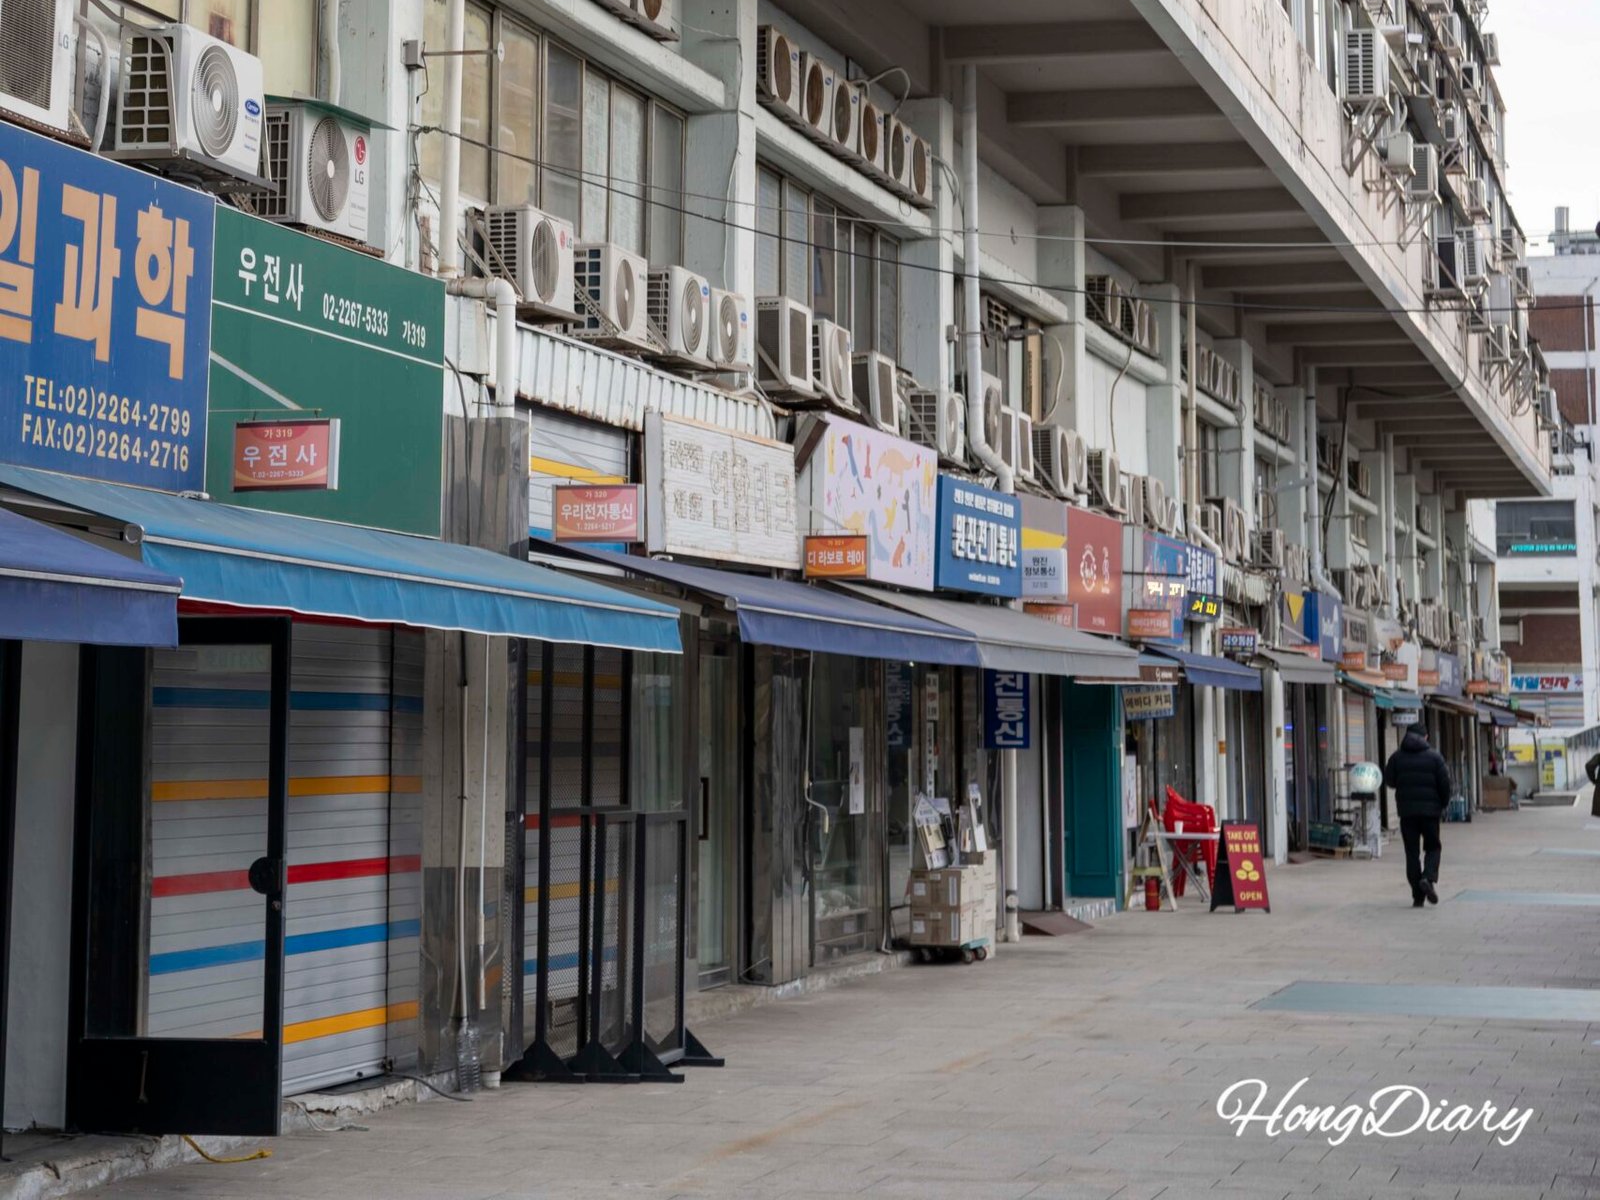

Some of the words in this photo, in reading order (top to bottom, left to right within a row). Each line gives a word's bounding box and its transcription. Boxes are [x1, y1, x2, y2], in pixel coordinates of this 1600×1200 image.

[354, 169, 364, 184] LG
[238, 247, 304, 311] 우전사
[322, 293, 388, 336] 02-2267-5333
[402, 320, 426, 348] 가319
[264, 429, 272, 439] 가
[275, 429, 293, 438] 319
[243, 443, 317, 468] 우전사
[561, 502, 633, 520] 우리전자통신
[954, 513, 1017, 568] 원진전자통신
[1024, 566, 1056, 577] 정보통신
[1227, 831, 1243, 841] TAKE
[1243, 831, 1257, 841] OUT
[1240, 891, 1263, 902] OPEN
